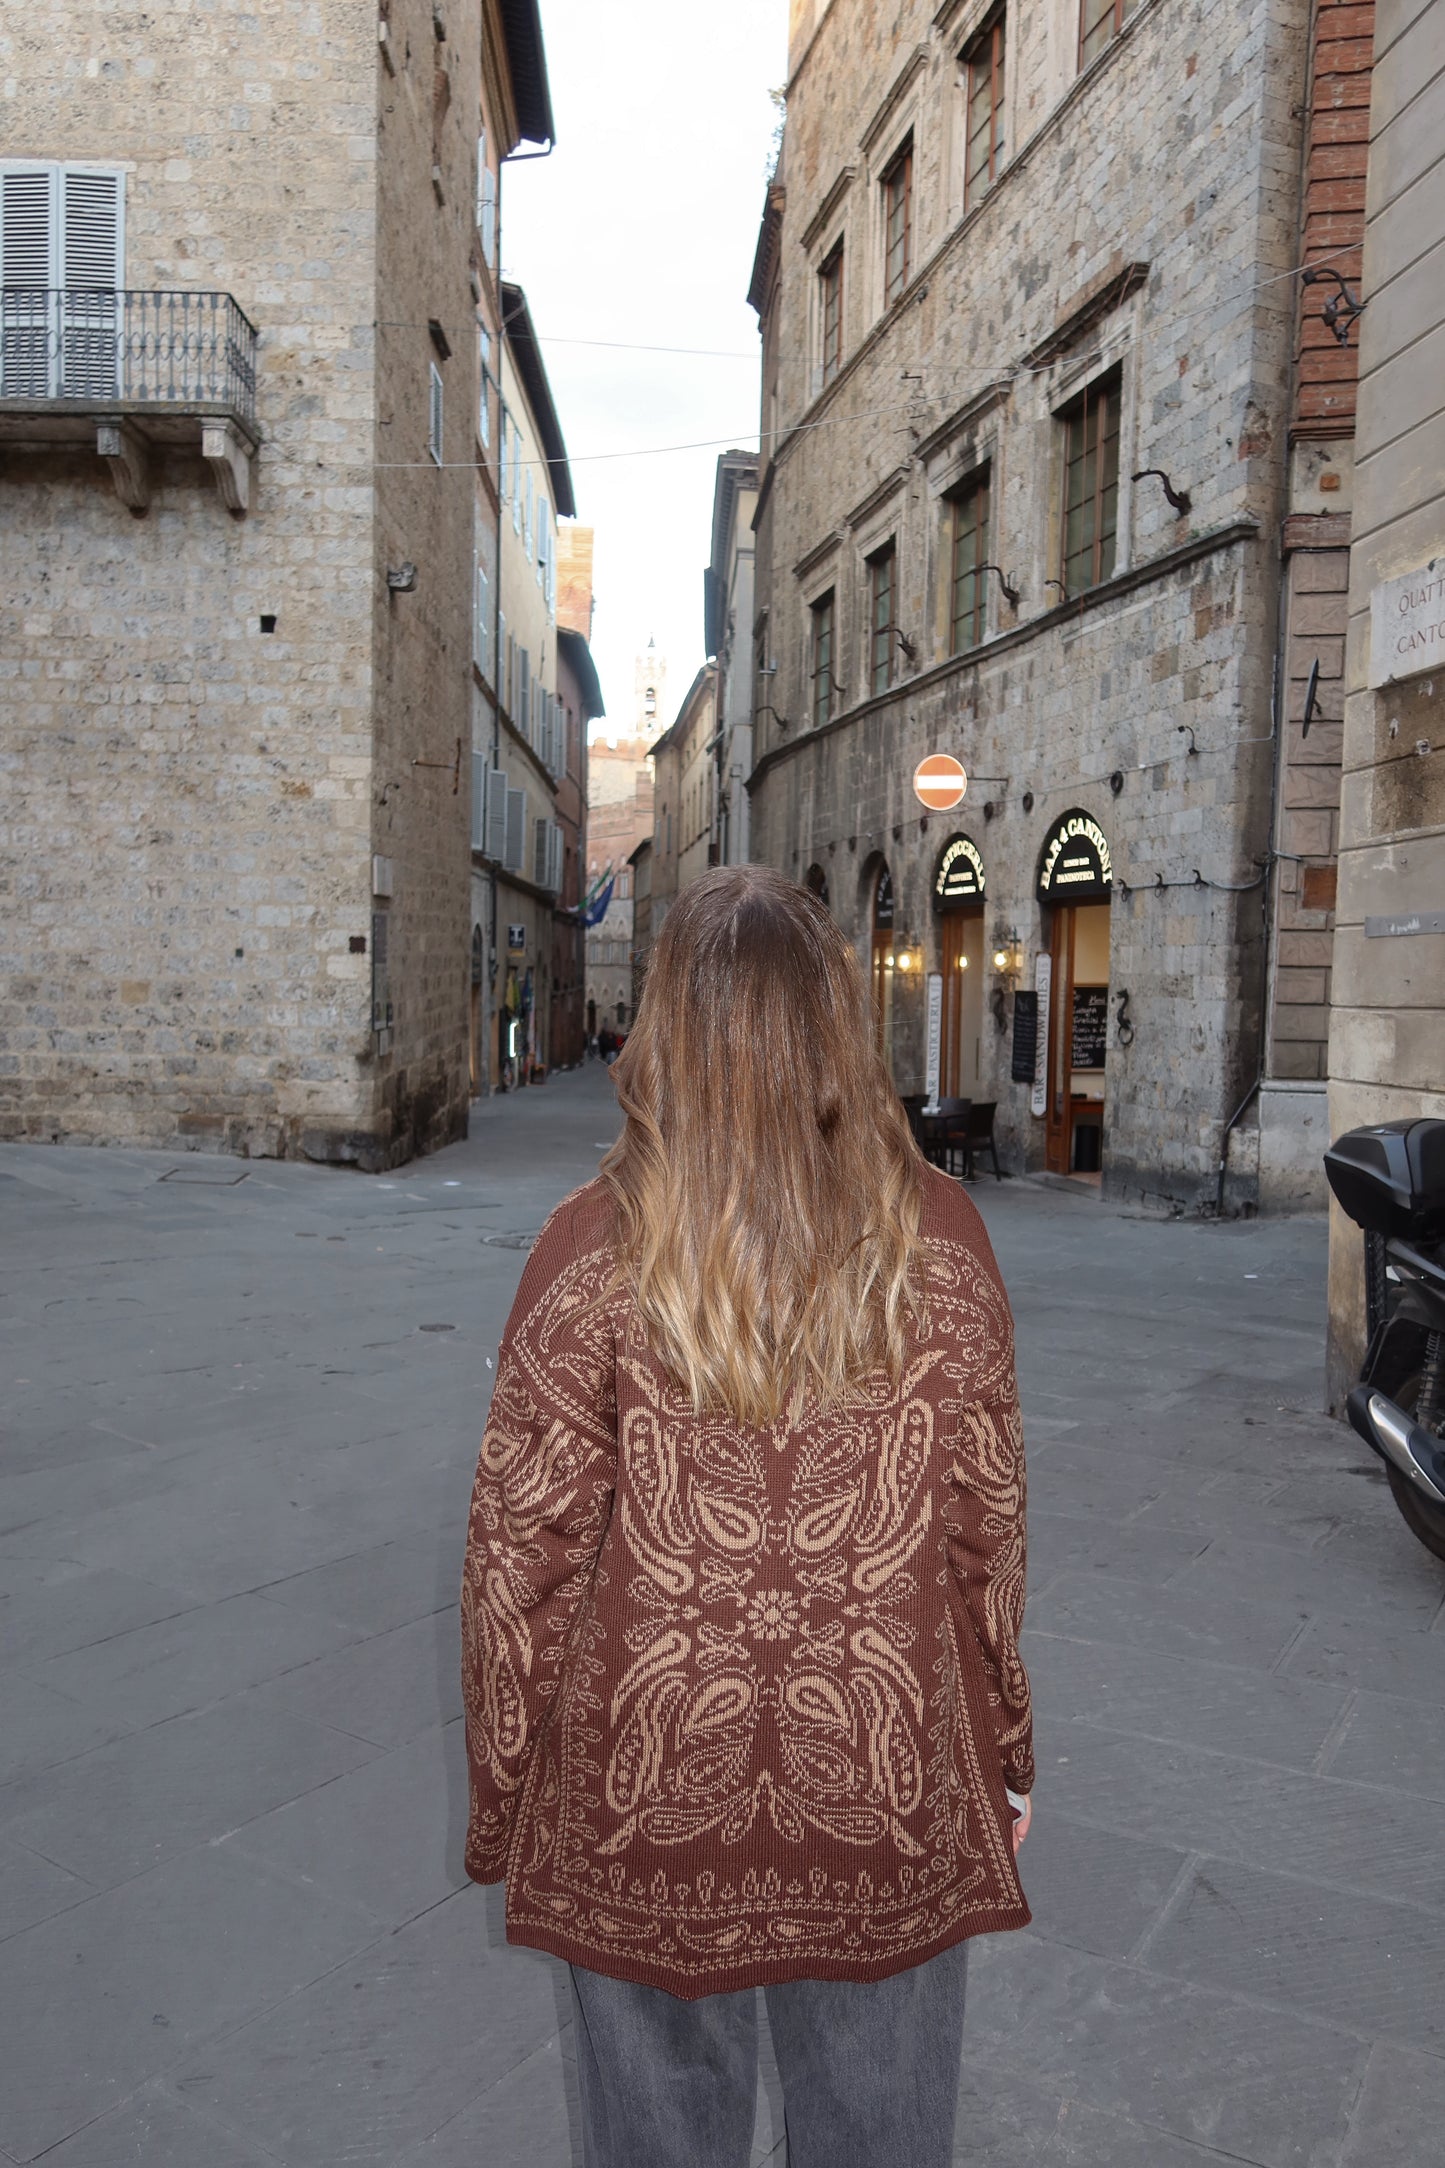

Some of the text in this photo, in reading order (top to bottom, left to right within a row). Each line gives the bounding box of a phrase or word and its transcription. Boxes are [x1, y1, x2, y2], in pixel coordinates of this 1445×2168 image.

[936, 840, 986, 895] PASTICCERIA
[1040, 817, 1113, 890] BAR 4 CANTONI
[928, 996, 940, 1072] PASTICCERIA
[1035, 976, 1049, 1068] SANDWICHES
[1034, 1078, 1046, 1105] BAR
